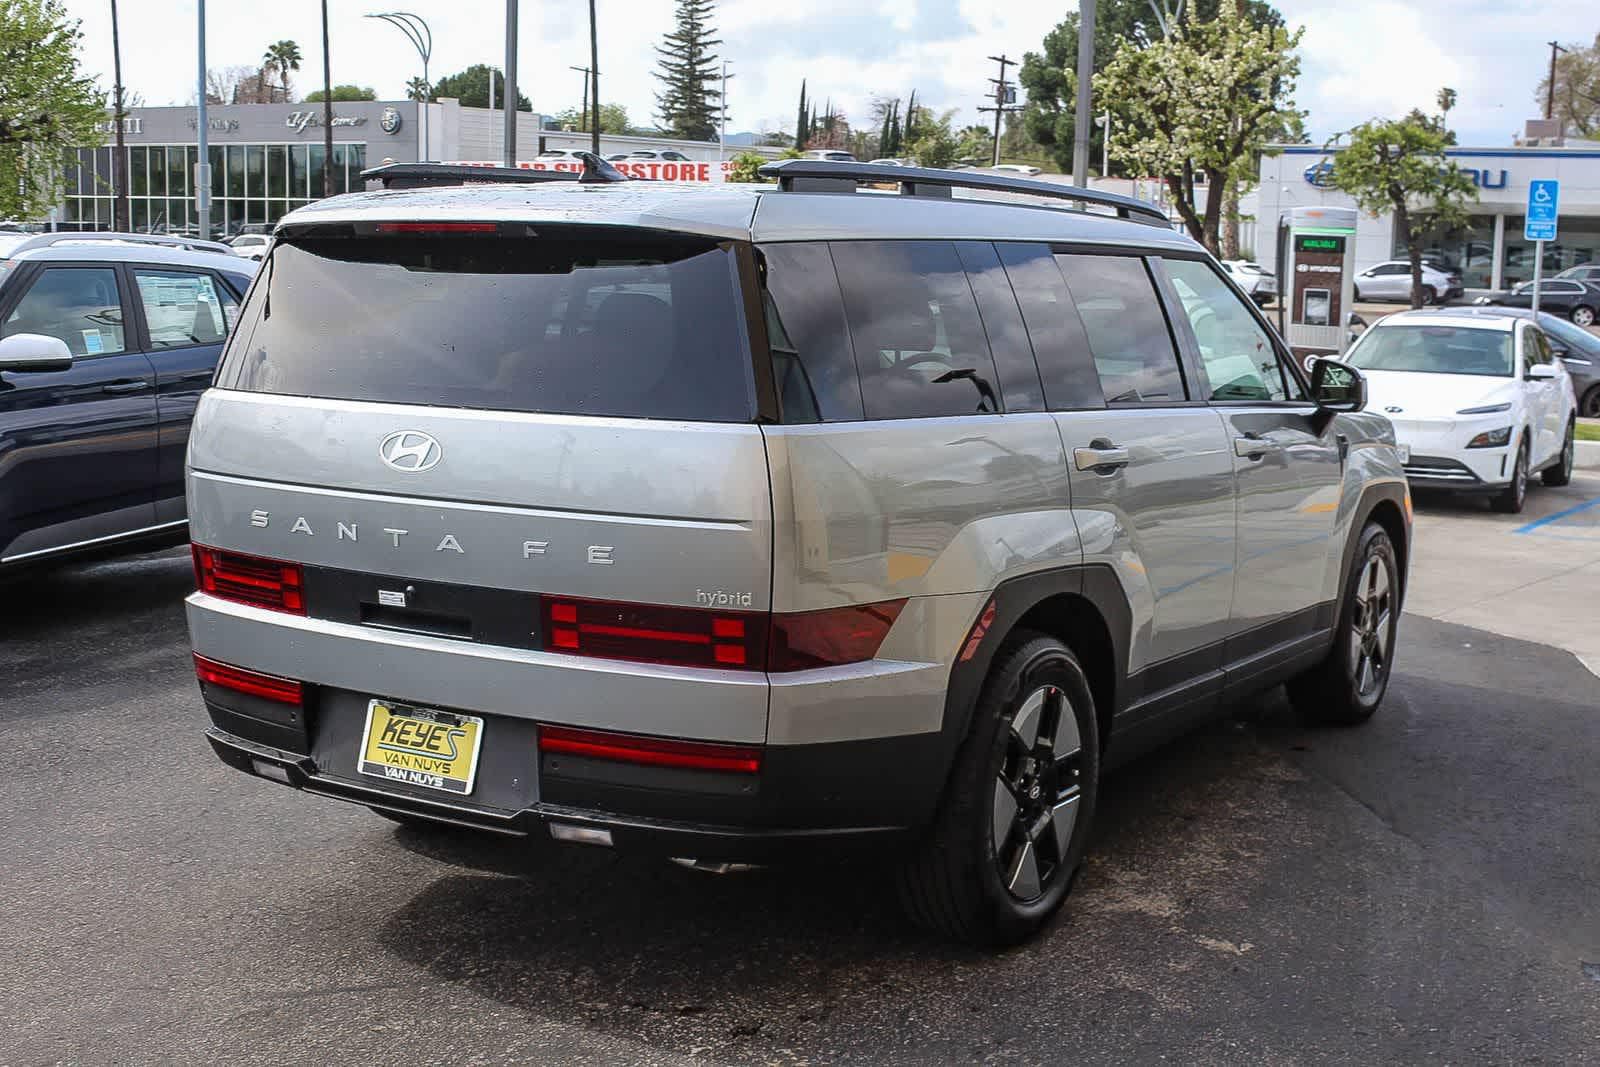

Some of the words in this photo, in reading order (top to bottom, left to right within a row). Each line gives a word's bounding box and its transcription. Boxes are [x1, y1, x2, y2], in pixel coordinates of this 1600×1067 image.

[250, 509, 465, 554] SANTA
[523, 540, 616, 565] FE
[696, 588, 753, 607] hybrid
[380, 717, 467, 762] KEYES
[384, 751, 410, 769] VAN
[414, 758, 452, 775] NUYS
[384, 765, 408, 780] VAN
[409, 772, 444, 788] NUYS
